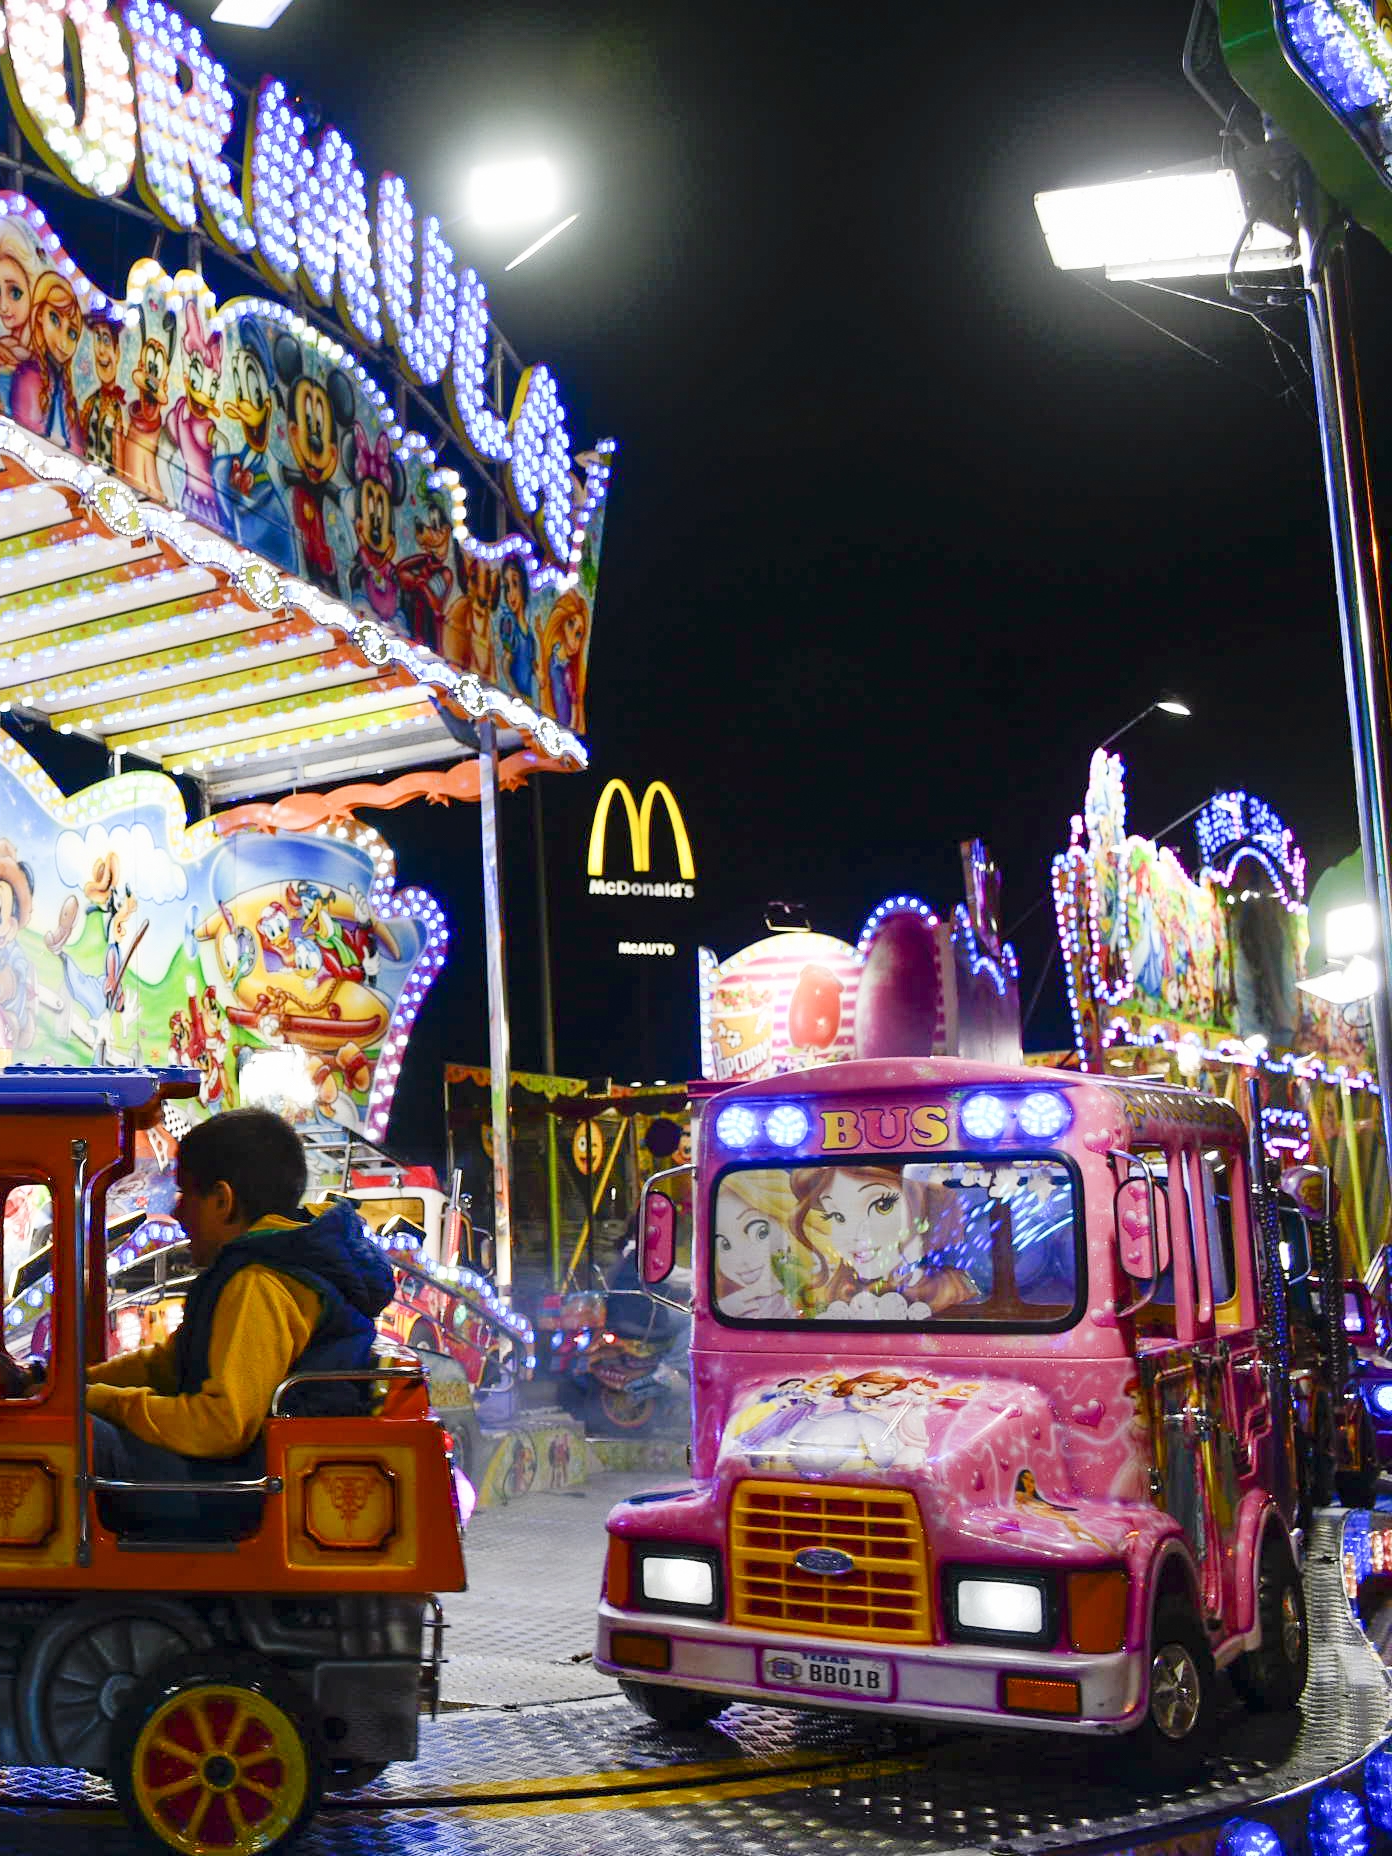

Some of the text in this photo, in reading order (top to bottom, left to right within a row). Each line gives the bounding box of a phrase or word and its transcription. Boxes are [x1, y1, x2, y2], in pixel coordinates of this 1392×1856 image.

[589, 878, 695, 899] McDonald's
[712, 1038, 770, 1080] POPCORN
[819, 1104, 950, 1151] BUS
[809, 1663, 881, 1689] BB01B
